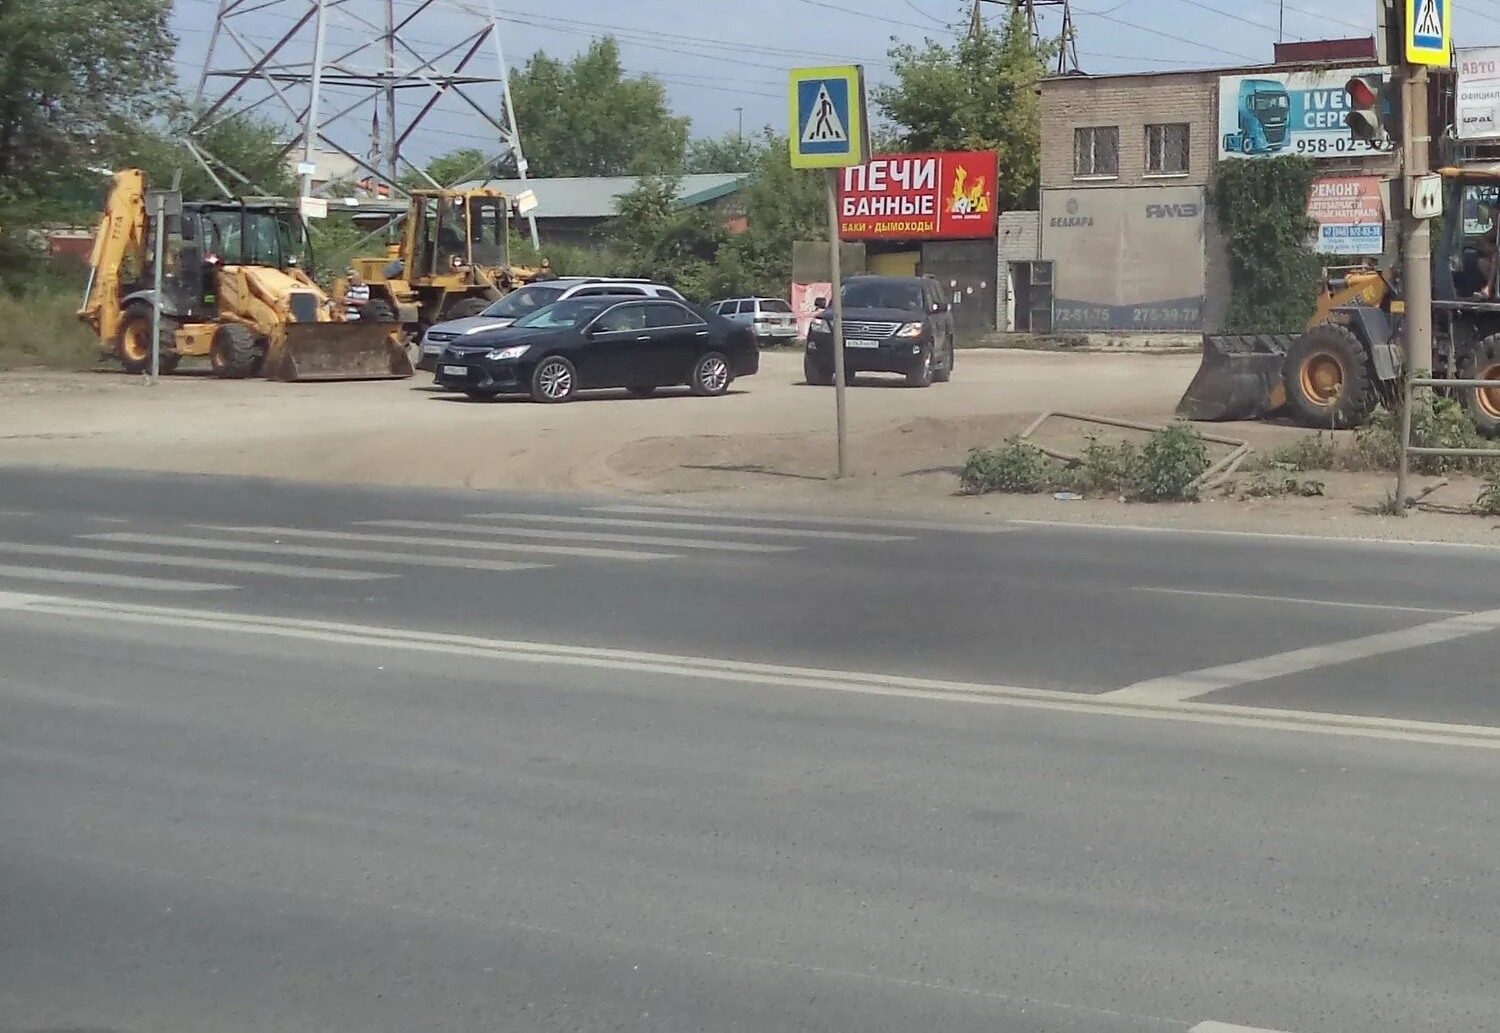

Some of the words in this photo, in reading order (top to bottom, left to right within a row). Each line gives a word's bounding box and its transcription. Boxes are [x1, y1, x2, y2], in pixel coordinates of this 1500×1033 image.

[1462, 61, 1495, 75] АВТО
[844, 158, 936, 192] ПЕЧИ
[1311, 183, 1360, 197] РЕМОНТ
[842, 195, 934, 216] БАННЫЕ
[1146, 203, 1198, 218] ЯМЗ
[842, 222, 866, 232] БАКИ
[874, 221, 933, 233] ДЫМОХОДЫ
